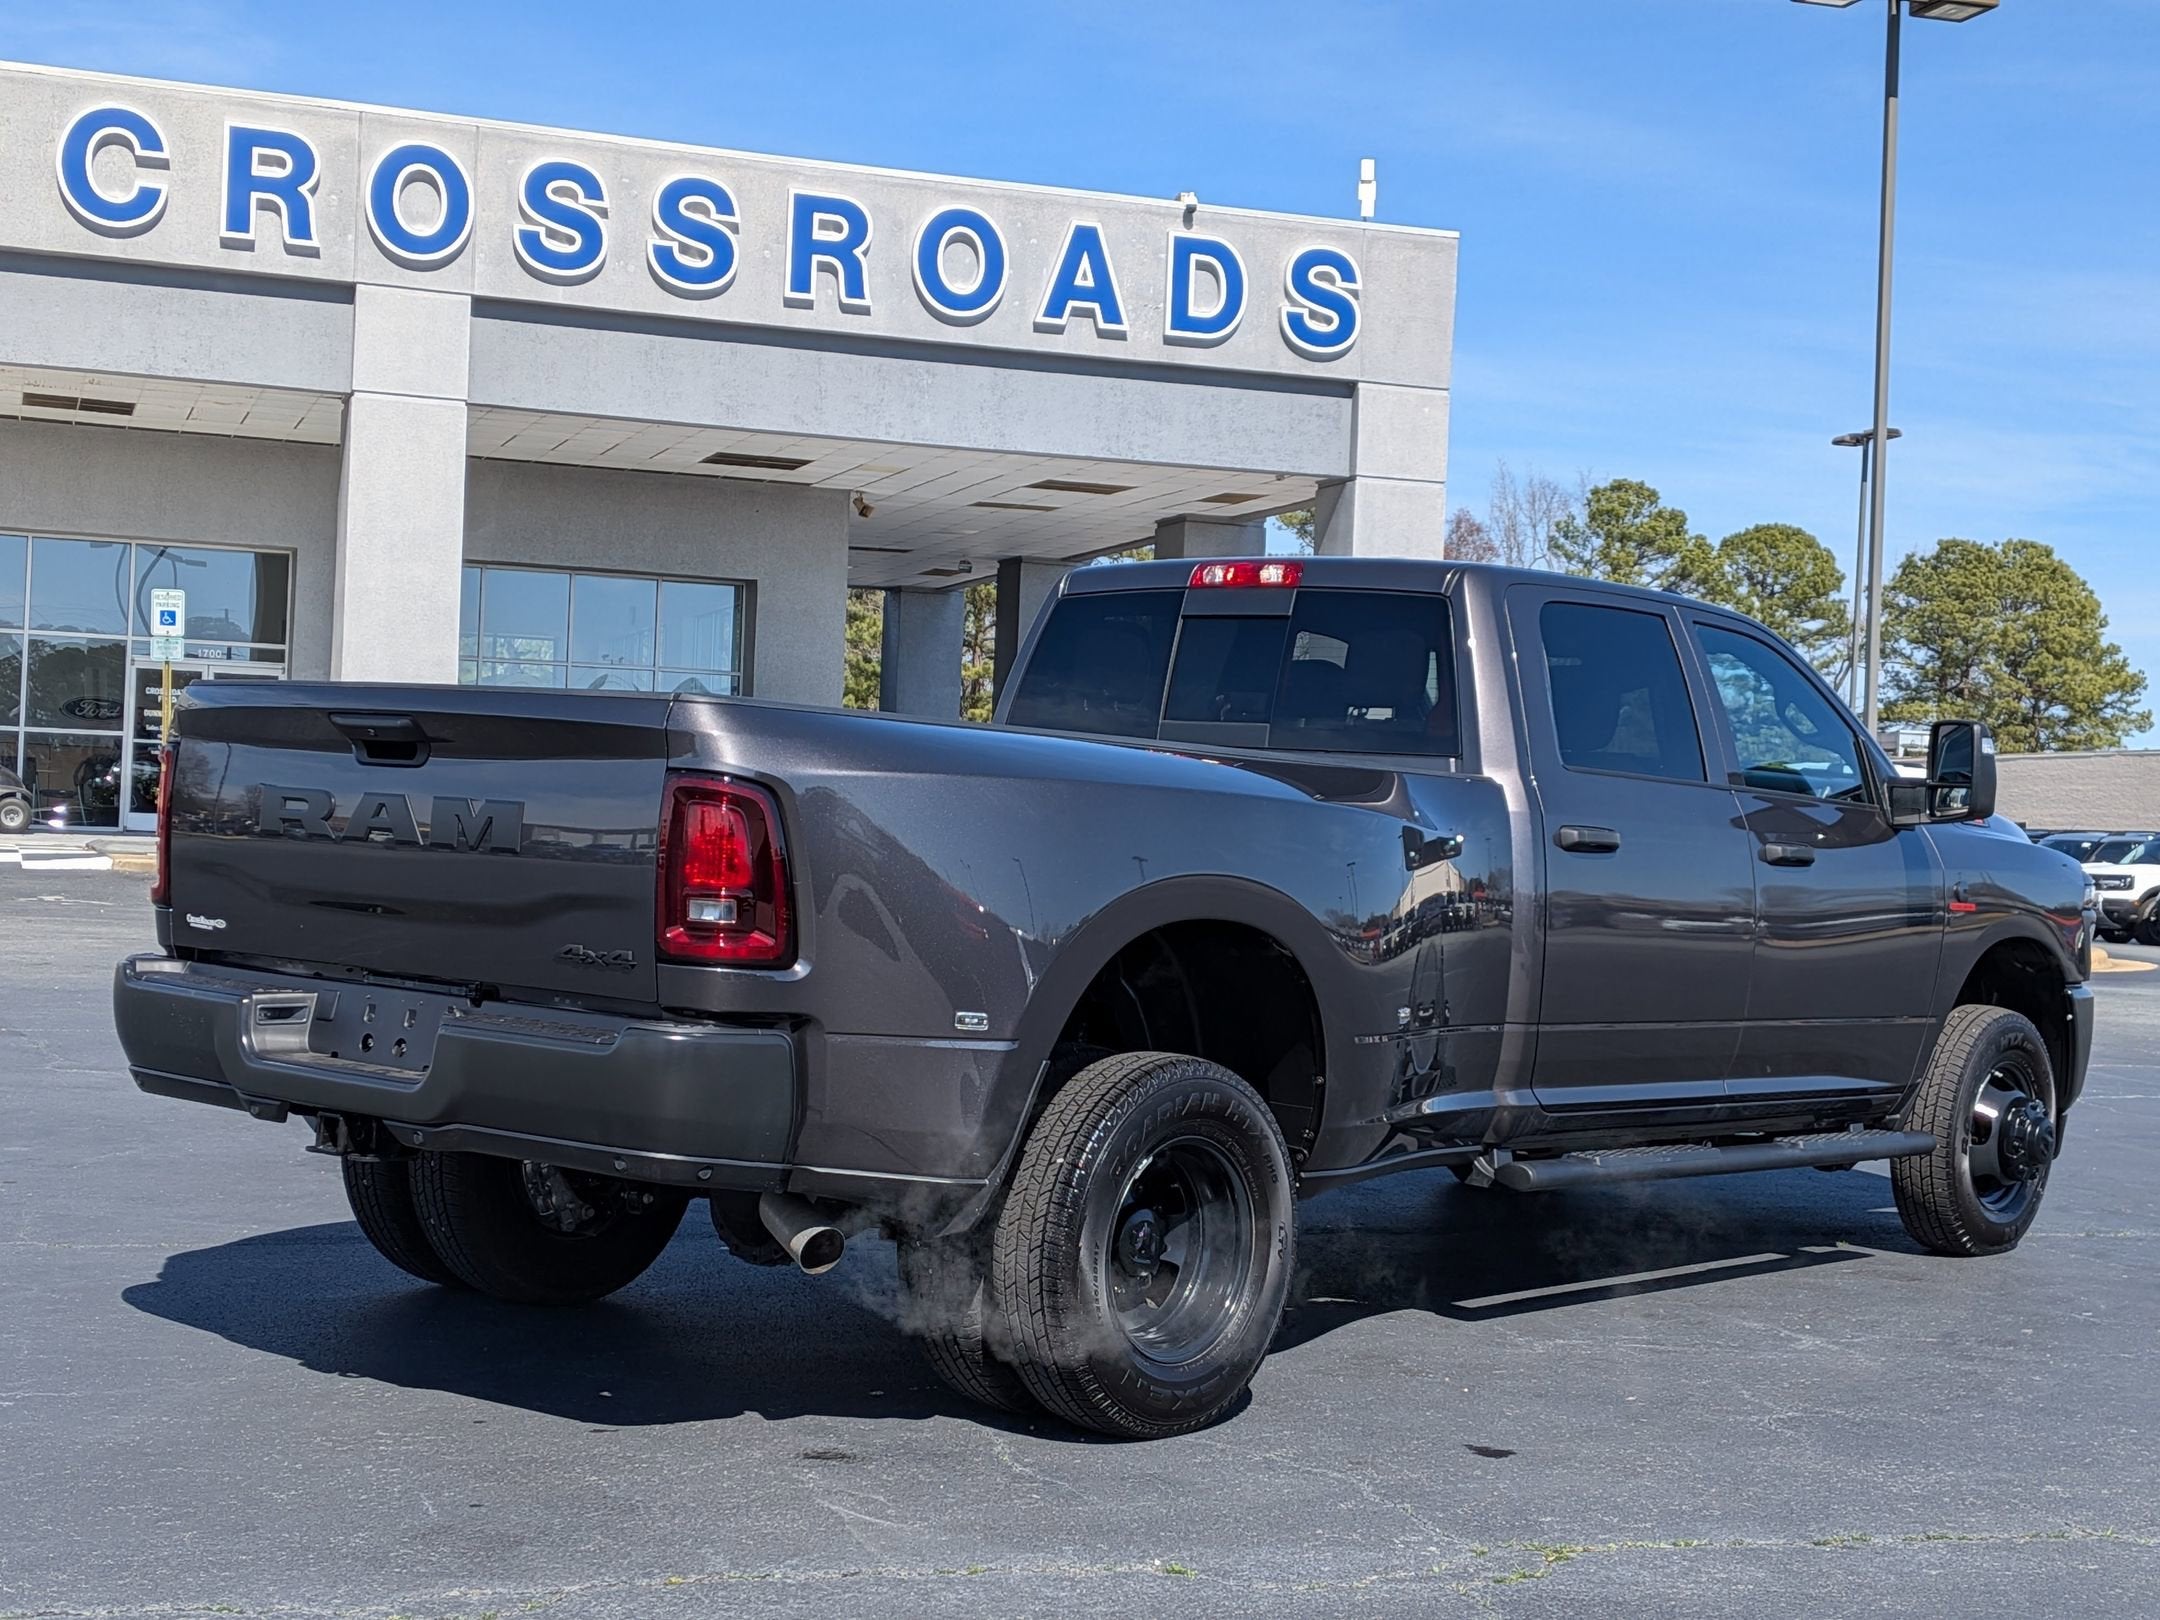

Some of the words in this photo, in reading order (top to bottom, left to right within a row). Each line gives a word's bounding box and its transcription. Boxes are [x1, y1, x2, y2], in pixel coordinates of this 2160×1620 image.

[56, 103, 1362, 361] CROSSROADS
[198, 648, 222, 658] 1700
[75, 700, 121, 717] Ford
[258, 782, 525, 855] RAM
